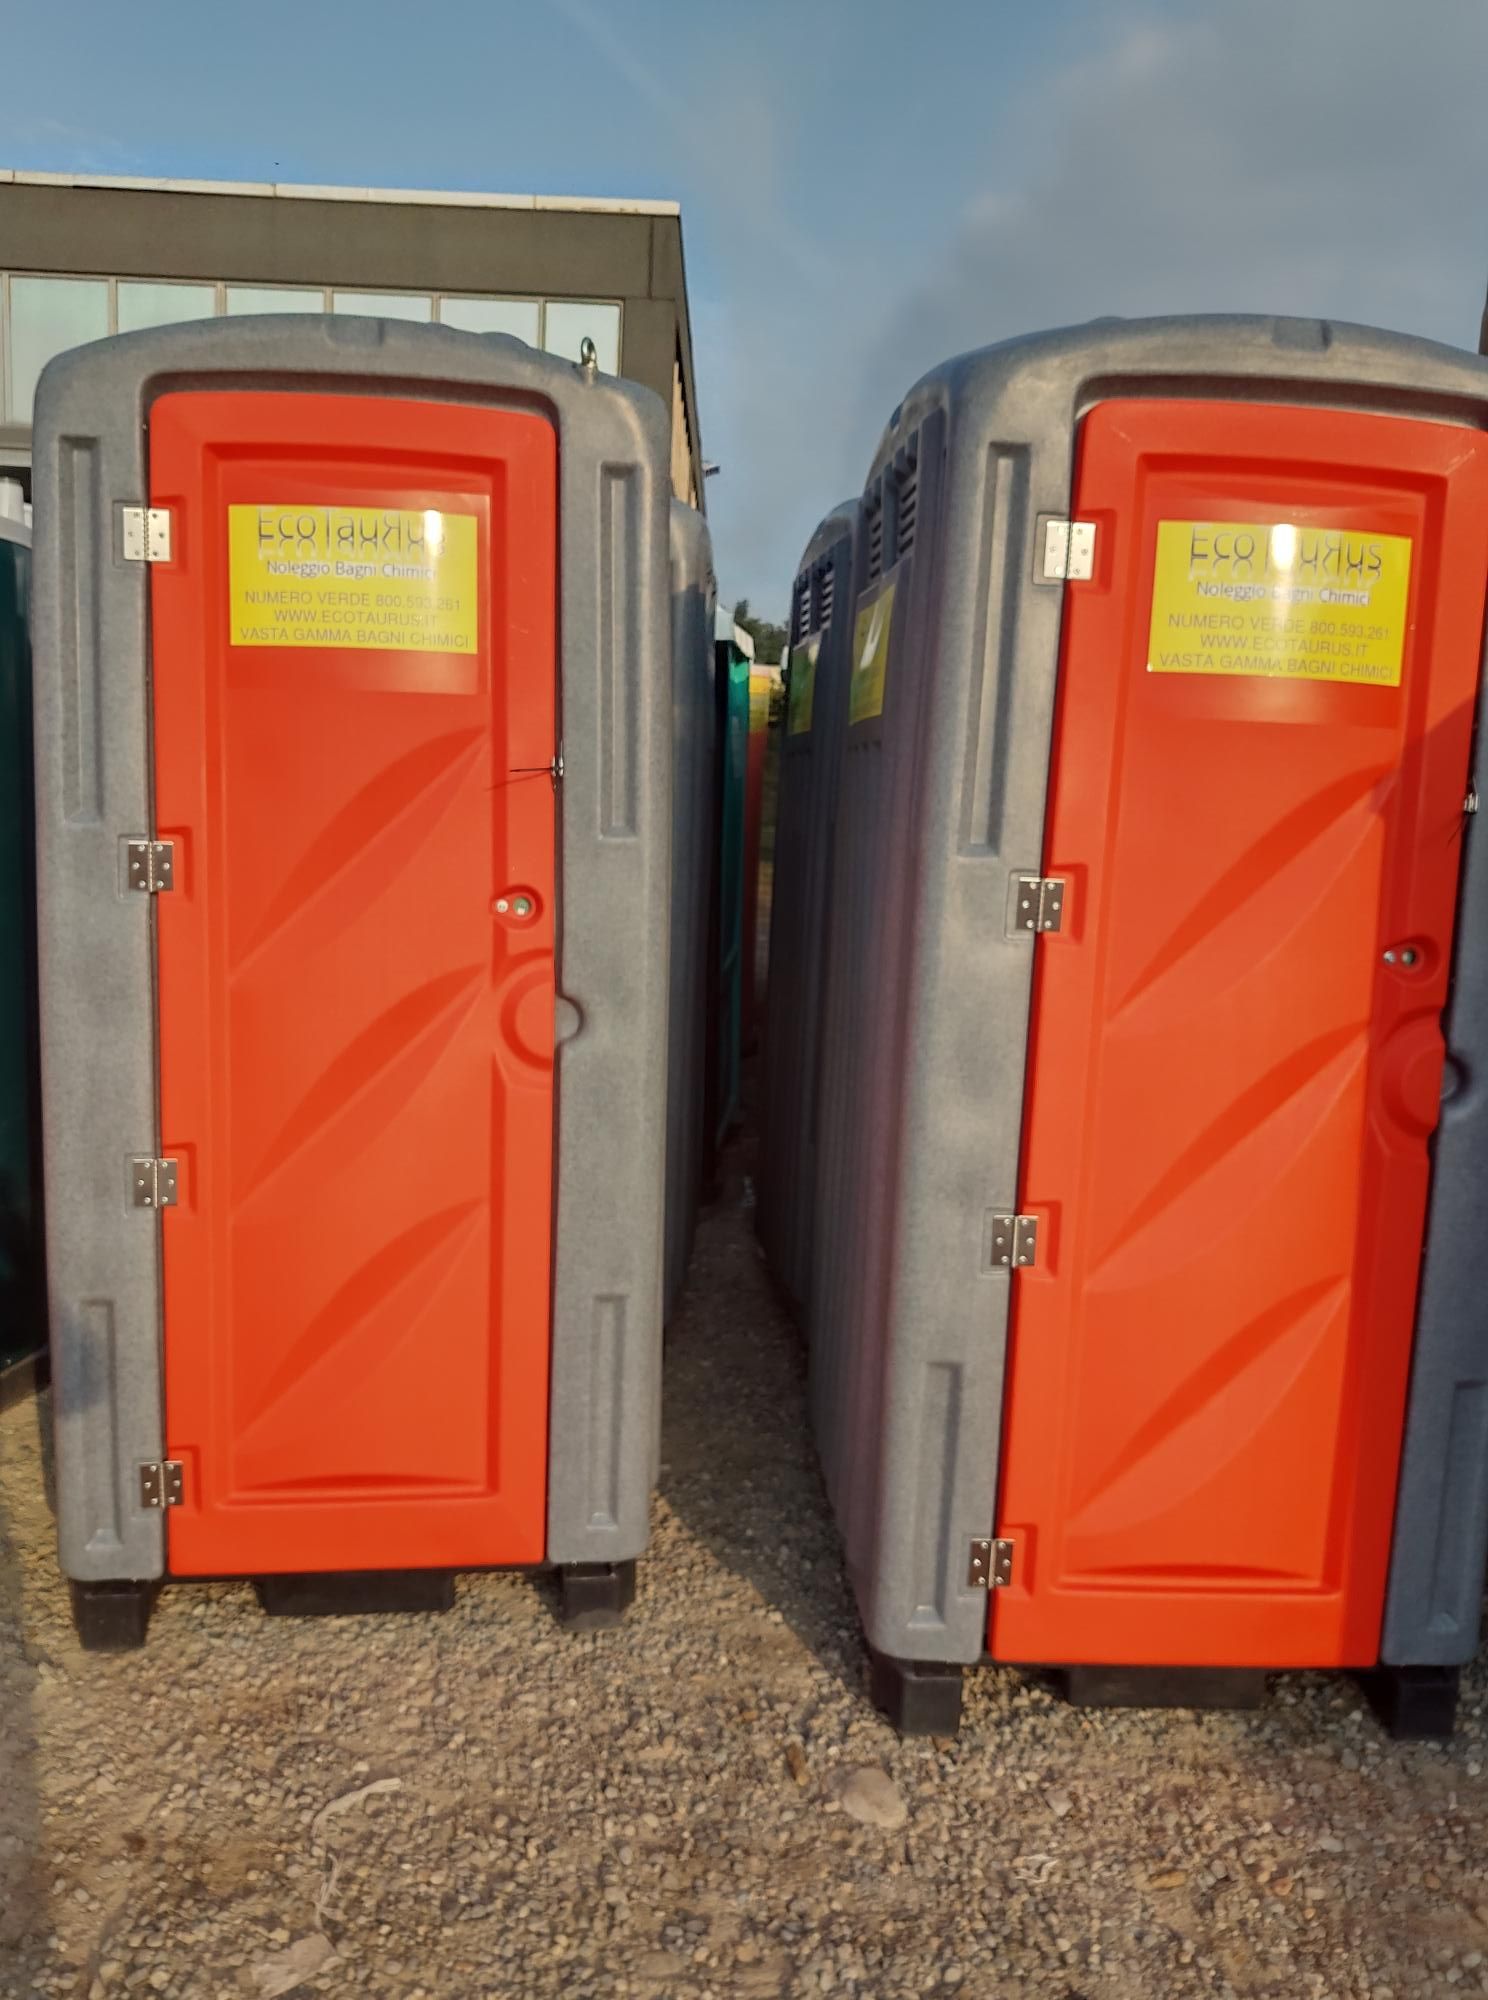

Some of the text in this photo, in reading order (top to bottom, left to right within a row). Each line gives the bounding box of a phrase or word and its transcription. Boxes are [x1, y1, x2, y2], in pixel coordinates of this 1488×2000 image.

[267, 560, 330, 578] Noleggio
[335, 561, 377, 580] Bagni
[245, 591, 461, 611] NUMERO VERDE 800.593261
[1196, 581, 1266, 601] Noleggio
[1319, 587, 1371, 605] Chimici
[240, 627, 469, 648] VASTA GAMMA BAGNI CHIMICI
[1168, 613, 1391, 640] NUMERO VERDE 800.593.261
[1200, 634, 1369, 657] WWW.ECOTAURUS.IT
[1159, 652, 1394, 680] VASTA GAMMA BAGNI CHIMICI
